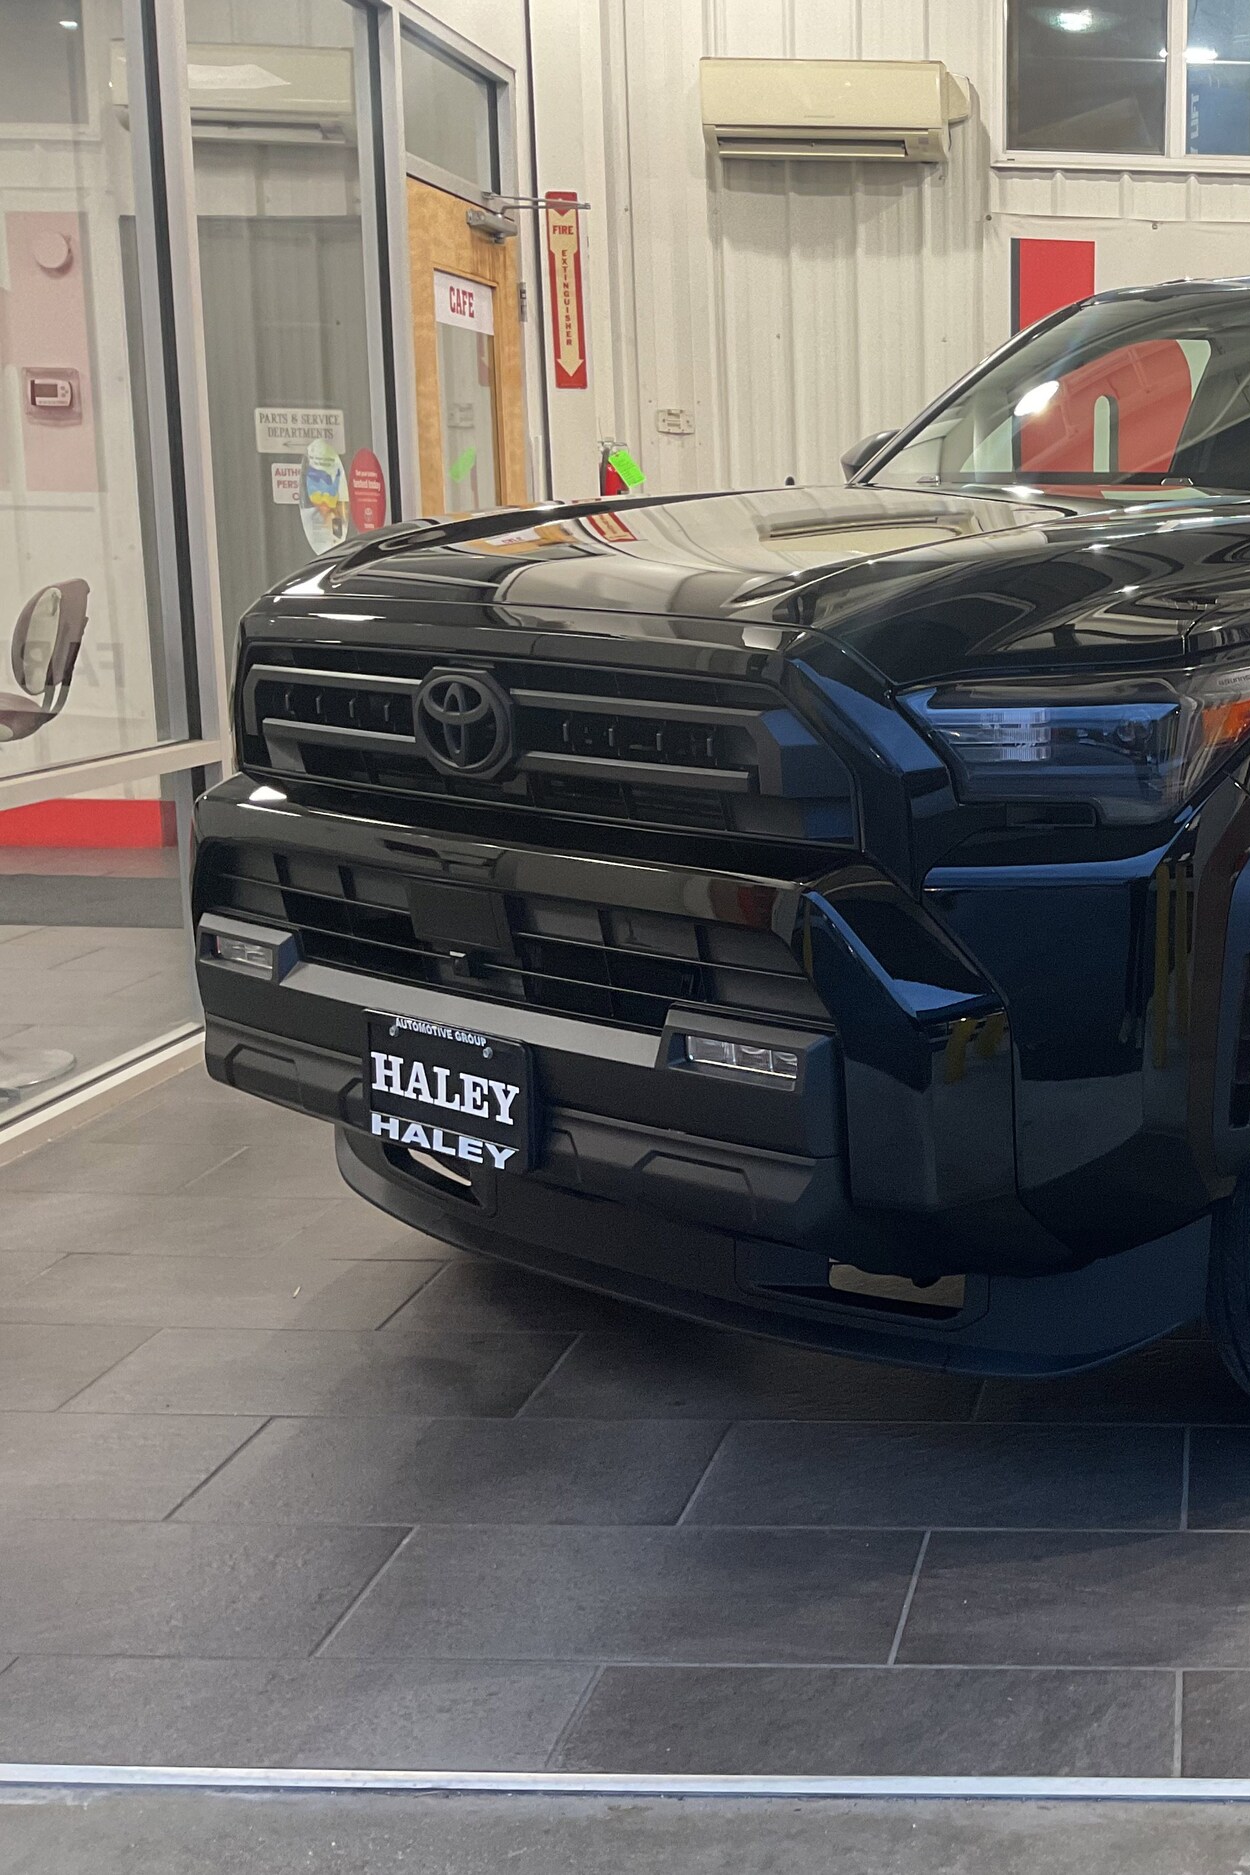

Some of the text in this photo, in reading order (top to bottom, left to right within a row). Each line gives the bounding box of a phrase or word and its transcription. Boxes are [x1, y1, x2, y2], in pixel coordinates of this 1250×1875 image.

[553, 225, 574, 235] FIRE
[449, 286, 474, 318] CAFE
[561, 249, 572, 346] EXTINGUISHER
[259, 412, 340, 426] PARTS & SERVICE
[268, 427, 334, 439] DEPARTMENTS
[395, 1018, 487, 1047] AUTOMOTIVE GROUP
[370, 1051, 520, 1125] HALEY
[371, 1113, 516, 1170] HALEY
